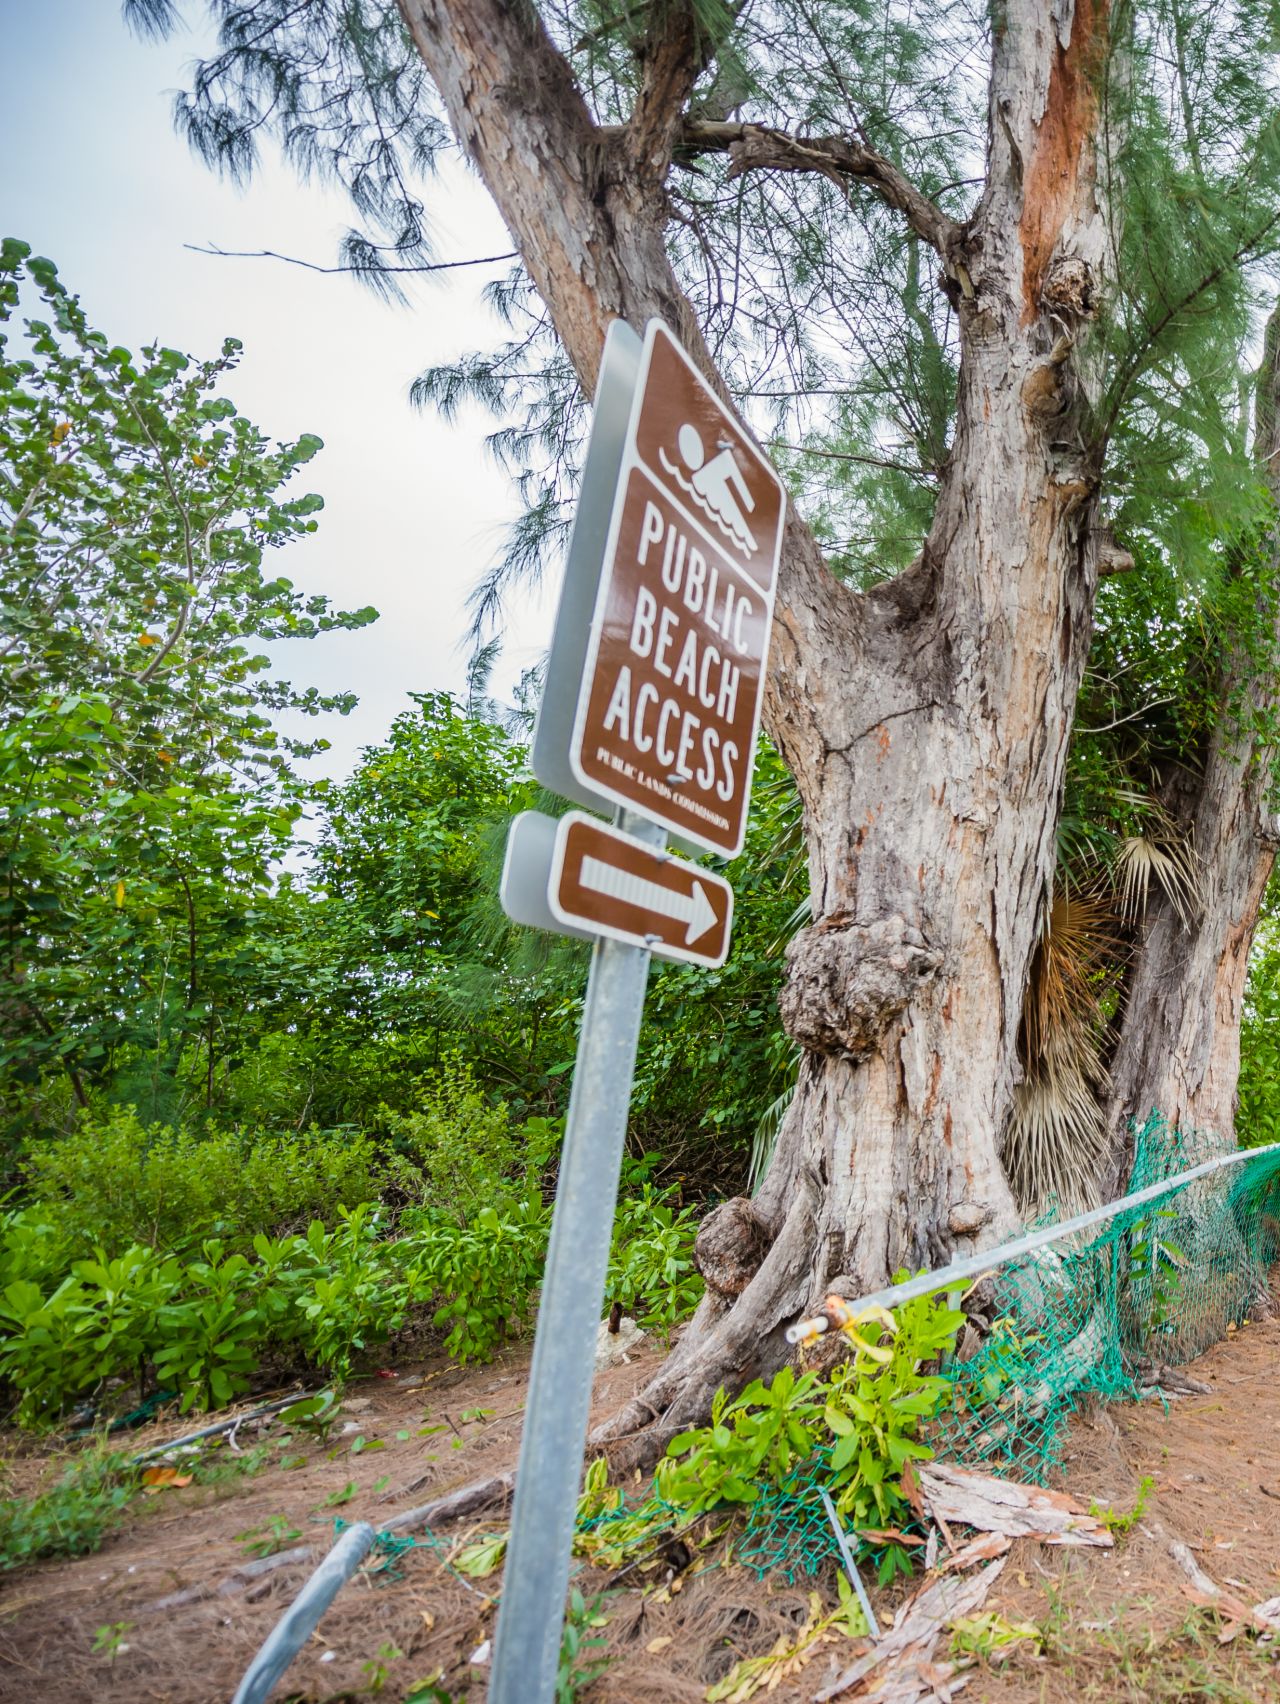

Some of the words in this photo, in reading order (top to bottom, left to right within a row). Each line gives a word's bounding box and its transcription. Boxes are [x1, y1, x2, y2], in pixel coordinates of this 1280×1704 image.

[637, 501, 753, 655] PUBLIC
[630, 586, 740, 724] BEACH
[596, 747, 637, 779] PUBLIC
[637, 771, 672, 800] LANDS
[603, 666, 738, 802] ACCESS
